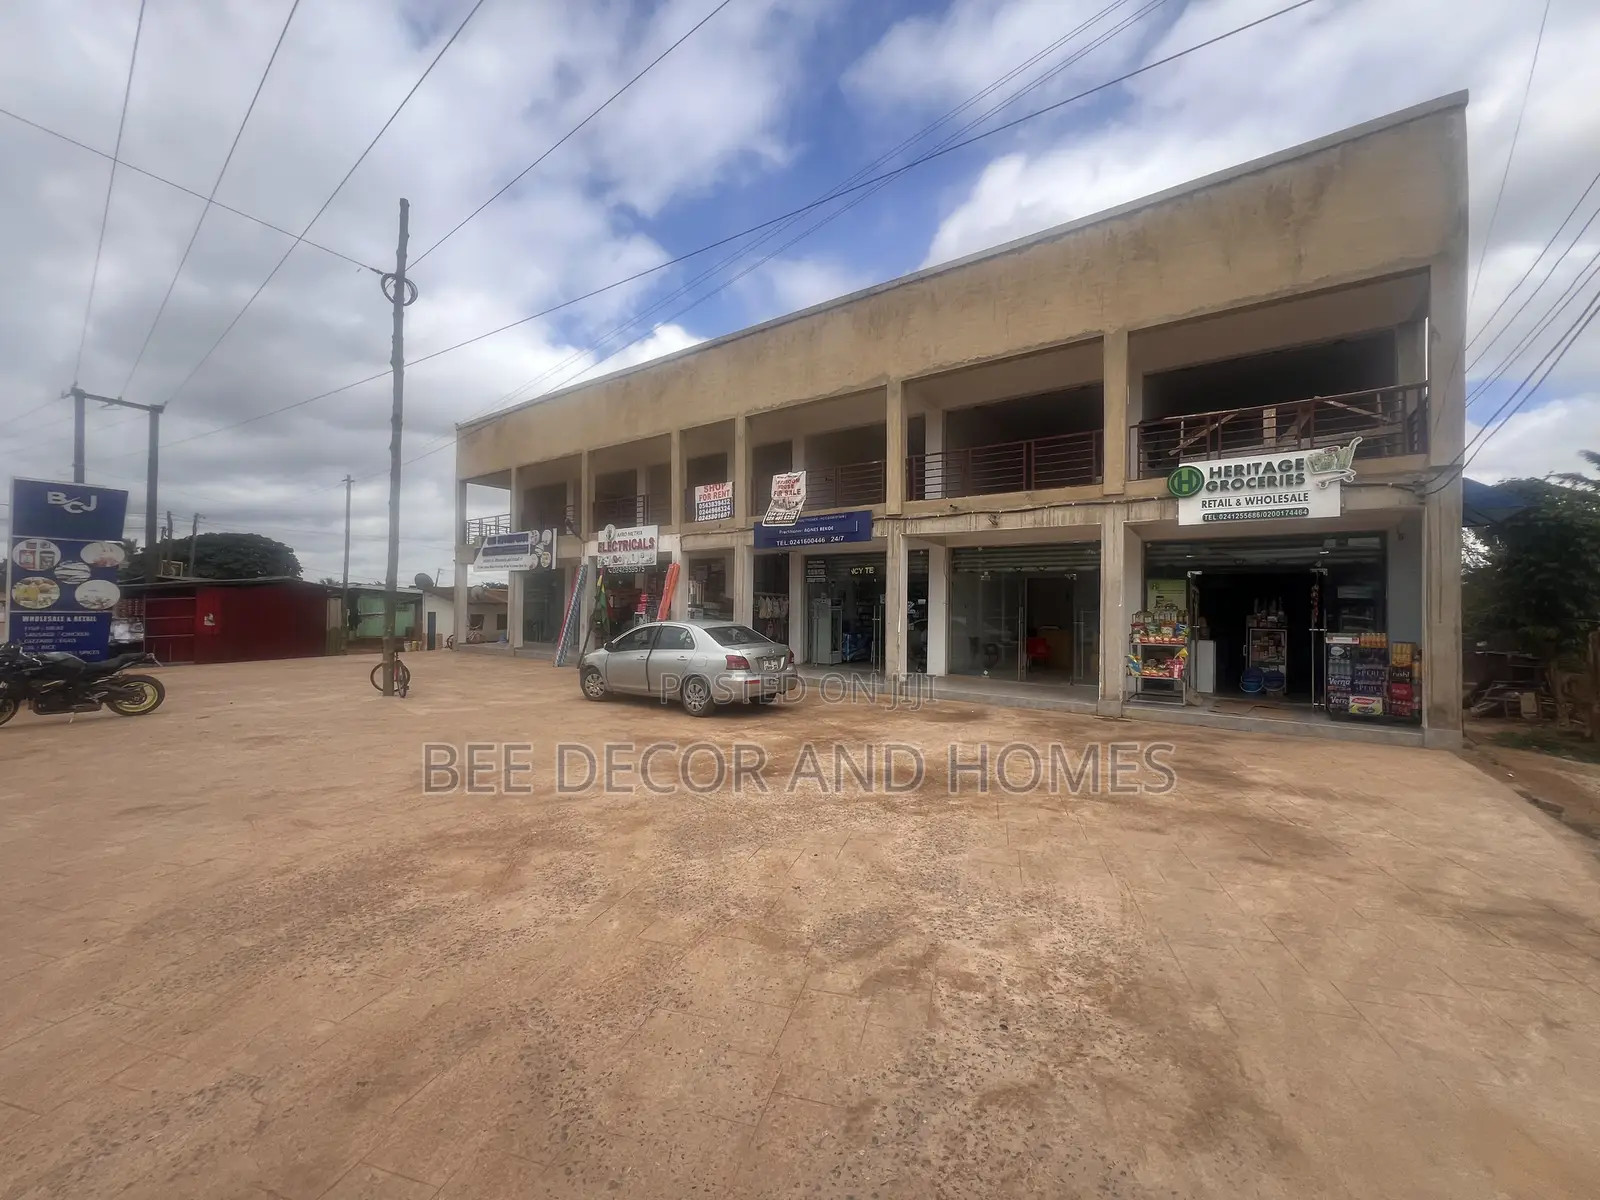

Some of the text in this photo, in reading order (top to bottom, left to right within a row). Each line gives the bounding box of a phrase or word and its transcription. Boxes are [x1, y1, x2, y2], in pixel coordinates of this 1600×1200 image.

[1209, 458, 1305, 479] HERITAGE
[1205, 473, 1306, 492] GROCERIES
[699, 490, 730, 502] FOR RENT
[784, 488, 802, 497] SALE
[1201, 492, 1309, 509] RETAIL & WHOLESALE
[598, 537, 656, 553] ELECTRICALS
